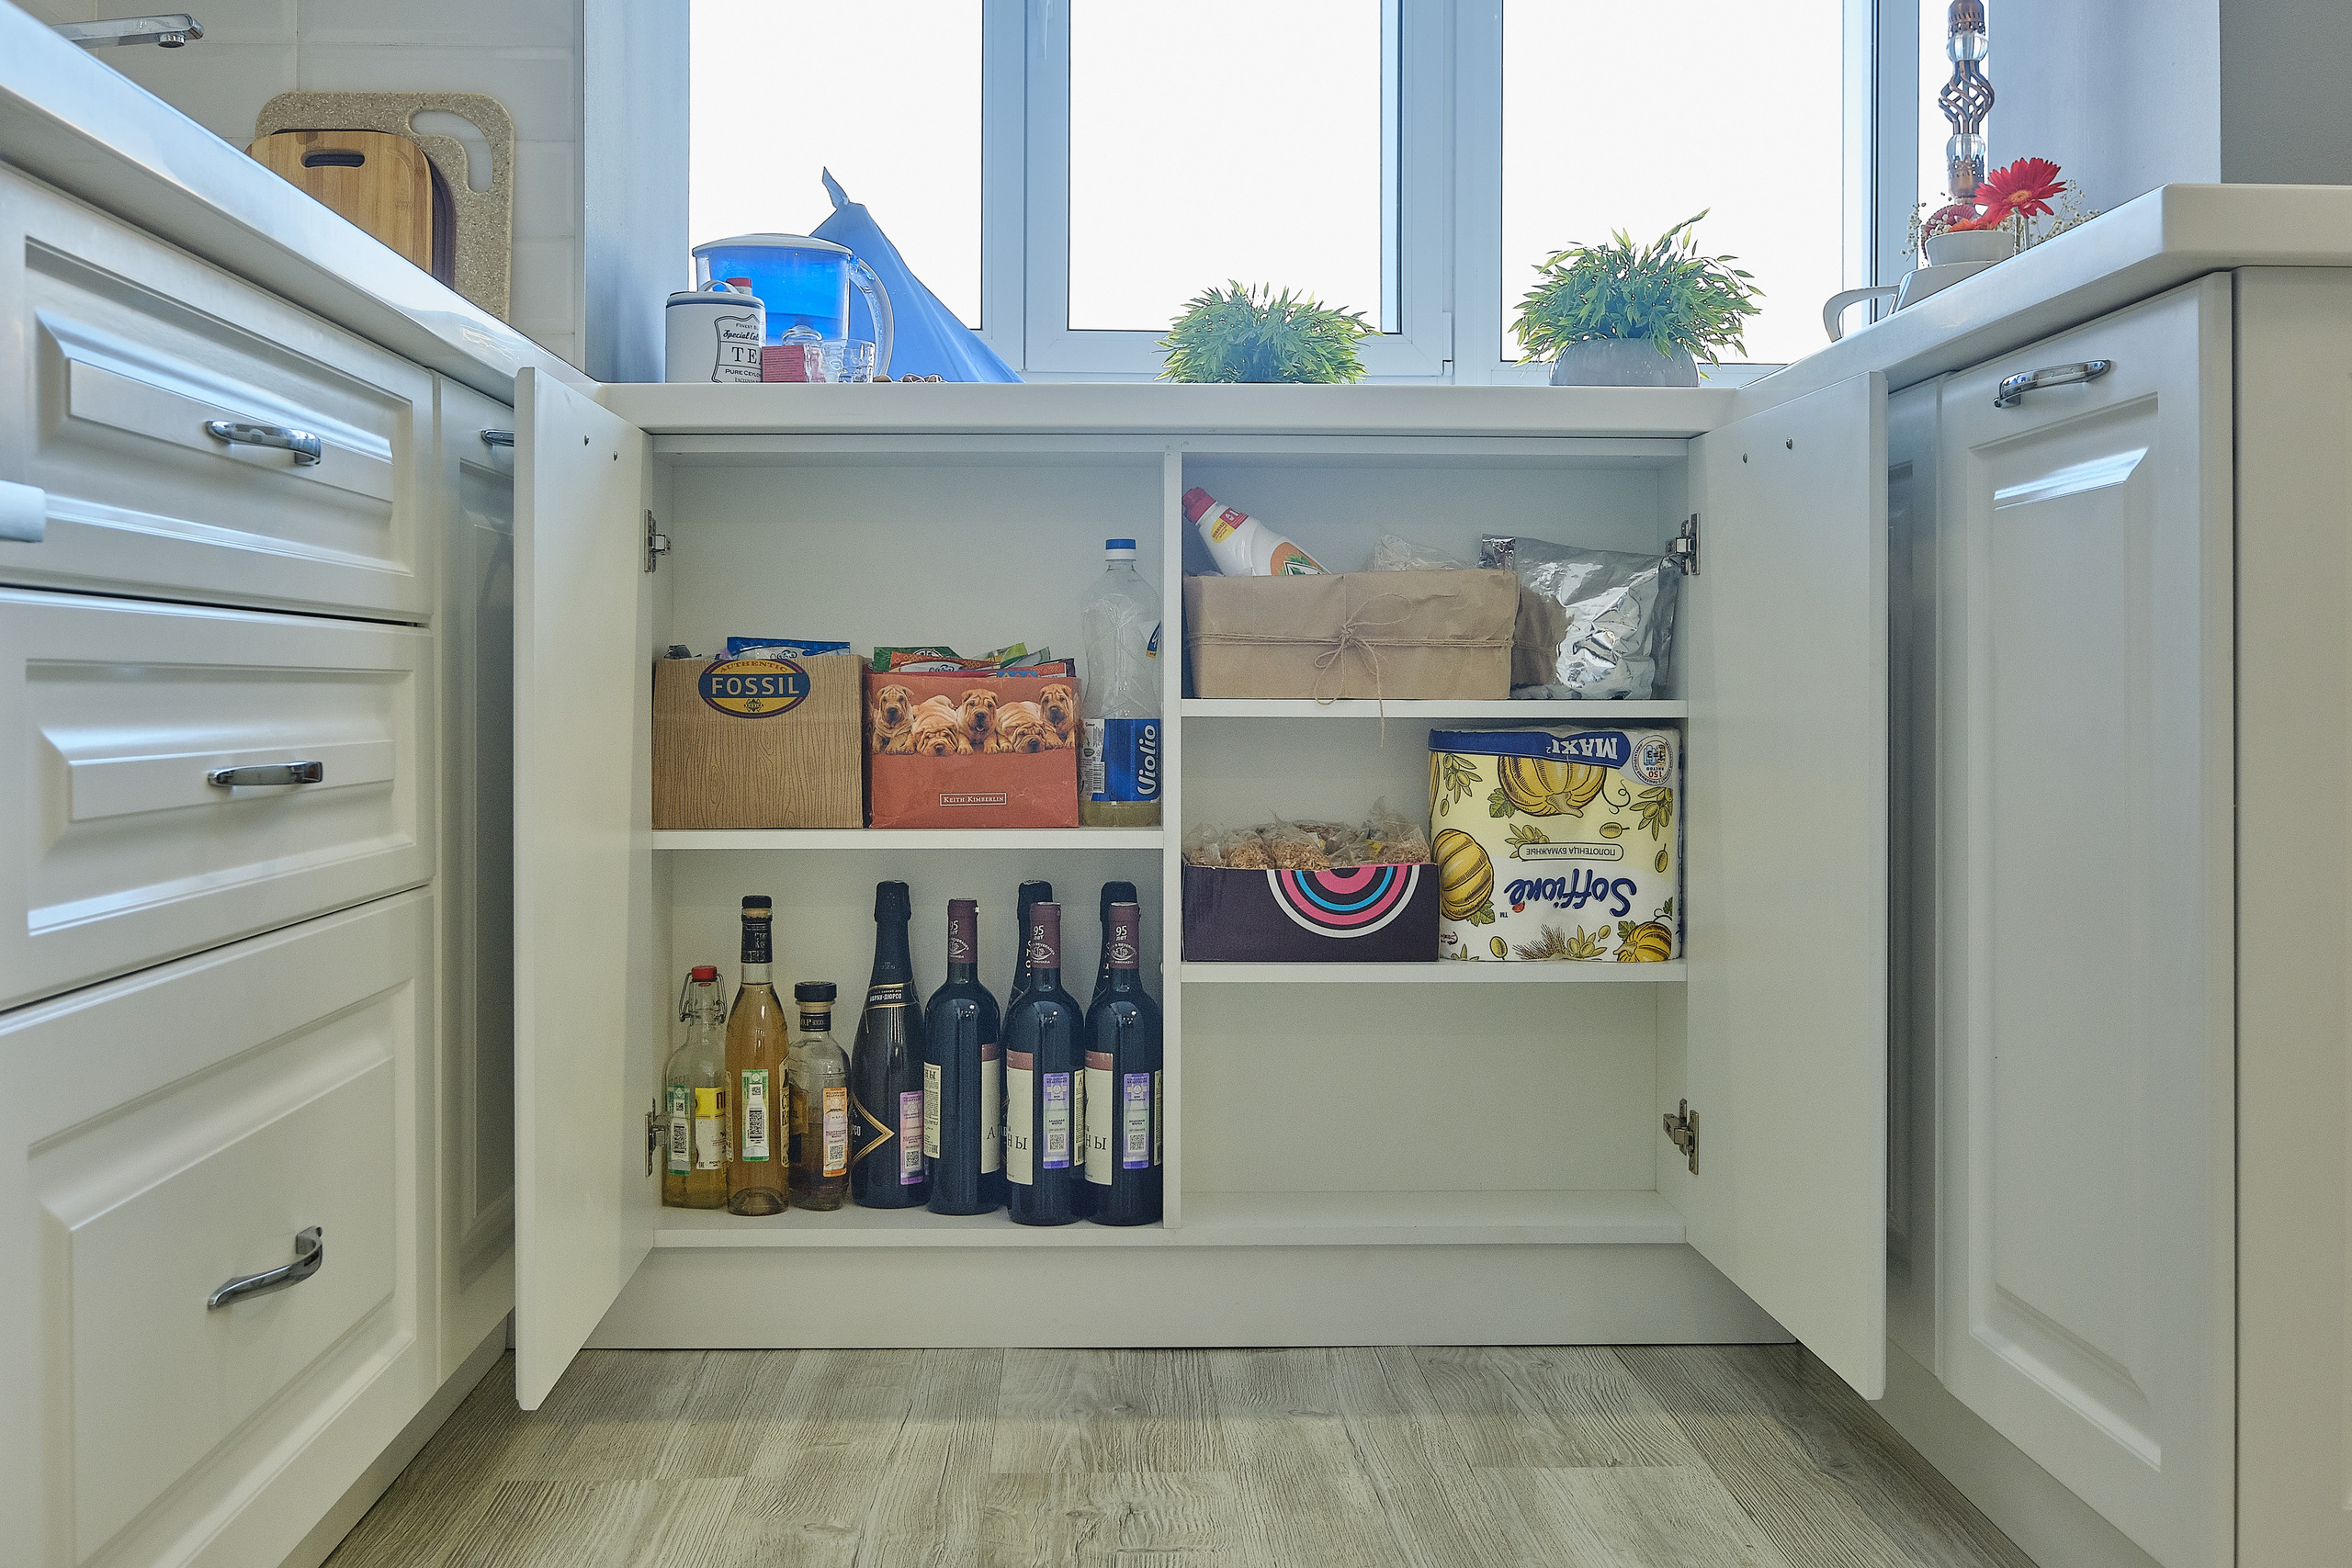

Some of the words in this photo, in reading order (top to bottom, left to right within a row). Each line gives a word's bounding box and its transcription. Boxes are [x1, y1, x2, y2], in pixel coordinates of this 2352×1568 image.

[723, 329, 750, 340] Special
[731, 346, 761, 366] TE
[720, 660, 788, 673] AUTHENTIC
[711, 676, 800, 695] FOSSIL
[1136, 723, 1157, 795] Violio
[1648, 770, 1663, 778] 150
[1525, 847, 1567, 856] БУМАЖНЫЕ
[1568, 846, 1616, 856] ПОЛОТЕНЦА
[1503, 868, 1638, 918] Soffione
[950, 919, 959, 931] 95
[1034, 924, 1045, 936] 95
[1115, 925, 1127, 937] 95
[1007, 1134, 1028, 1150] НЫ
[1085, 1134, 1107, 1151] НЫ
